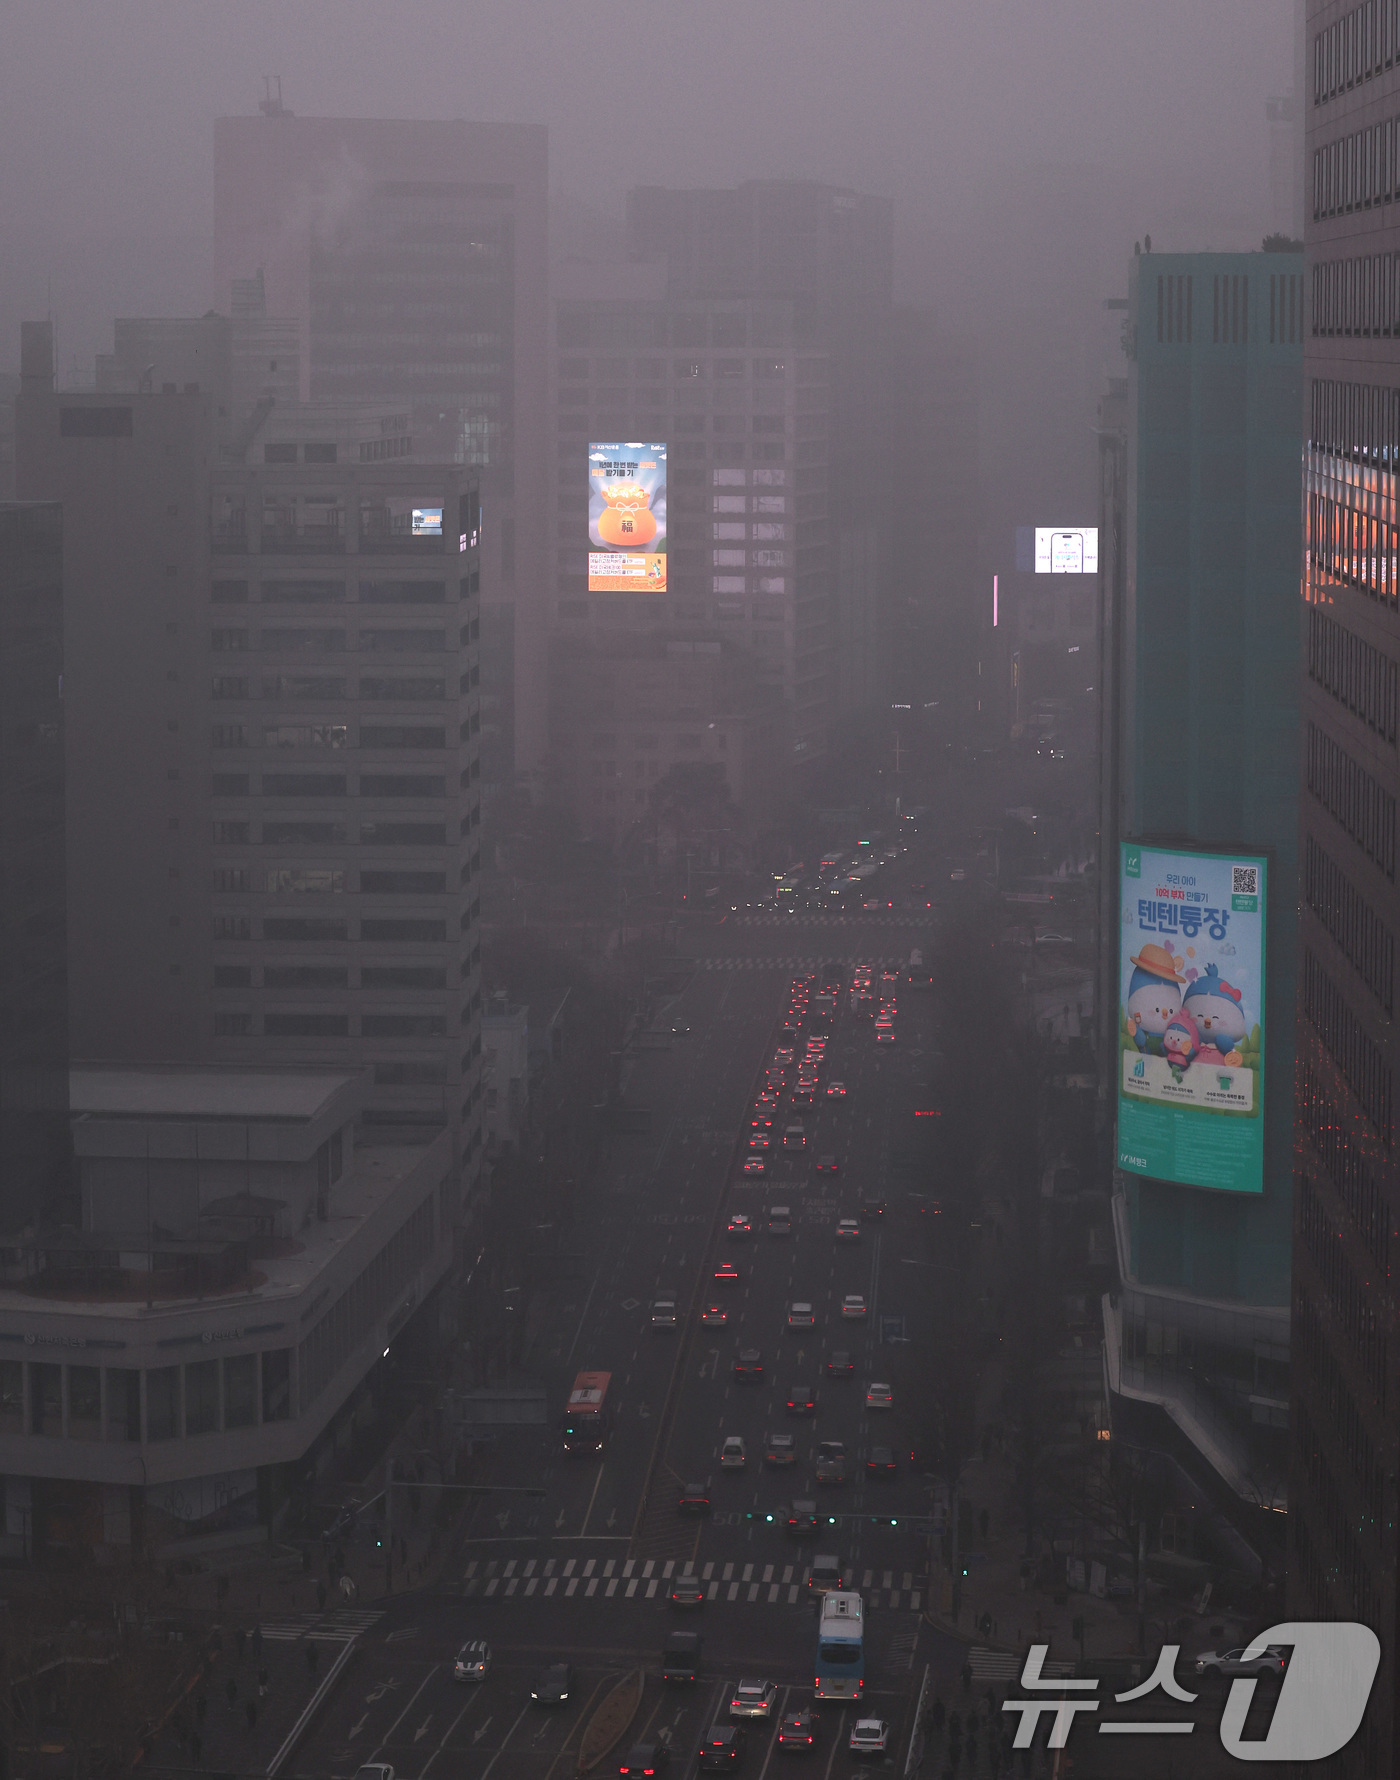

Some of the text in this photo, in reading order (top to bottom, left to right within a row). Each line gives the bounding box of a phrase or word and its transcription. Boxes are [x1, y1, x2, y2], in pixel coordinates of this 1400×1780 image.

[621, 520, 634, 533] 福
[1166, 873, 1196, 887] 우리 아이
[1155, 887, 1209, 903] 10억 부자 만들기
[1137, 899, 1231, 941] 텐텐통장
[1128, 1155, 1147, 1168] iM뱅크
[712, 1511, 742, 1526] 50
